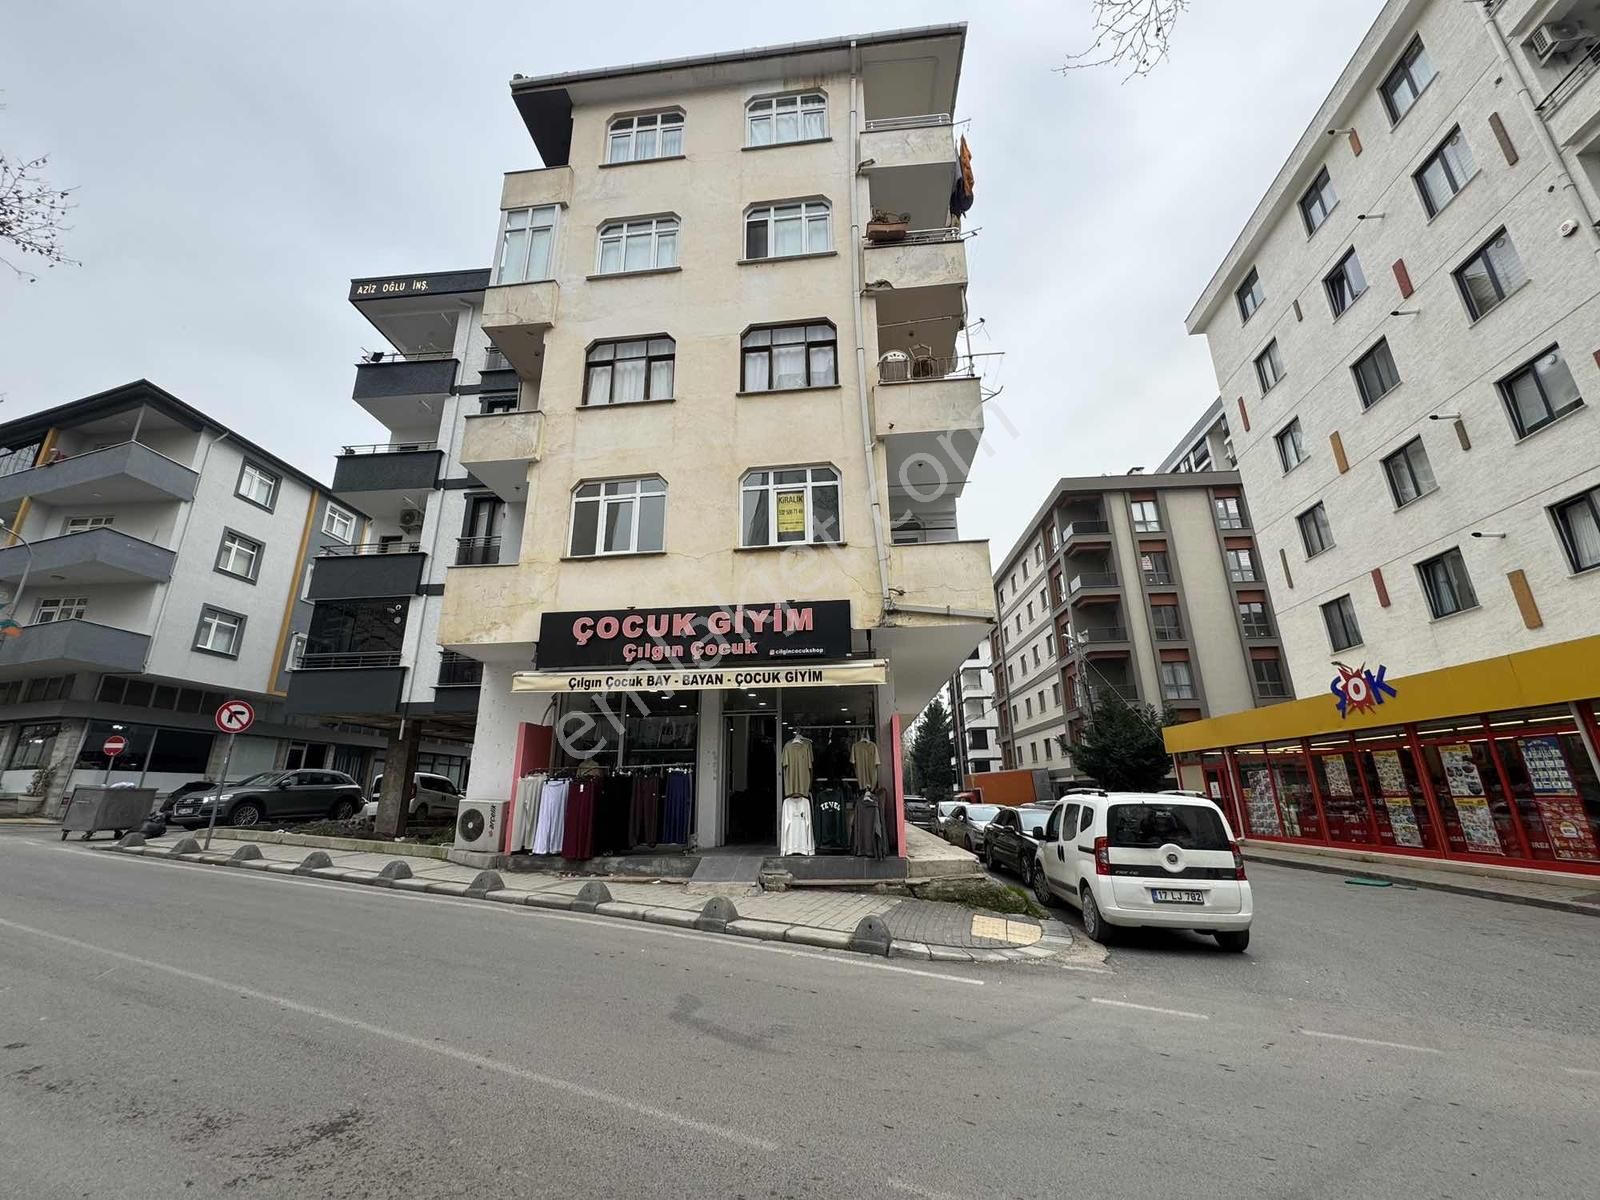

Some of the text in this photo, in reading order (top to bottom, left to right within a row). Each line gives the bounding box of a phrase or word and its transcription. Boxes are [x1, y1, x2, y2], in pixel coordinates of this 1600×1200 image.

[357, 283, 376, 294] AZİZ
[382, 281, 405, 292] OĞLU
[572, 602, 814, 646] ÇOCUK GİYİM
[622, 639, 758, 662] Çılgın Çocuk
[568, 677, 602, 691] Çılgın
[605, 675, 643, 690] Çocuk
[646, 674, 672, 687] BAY
[682, 673, 724, 686] BAYAN
[734, 671, 781, 687] ÇOCUK
[785, 668, 823, 683] GİYİM
[1330, 664, 1397, 719] ŞOK
[1158, 891, 1167, 899] 17
[1171, 891, 1182, 900] LJ
